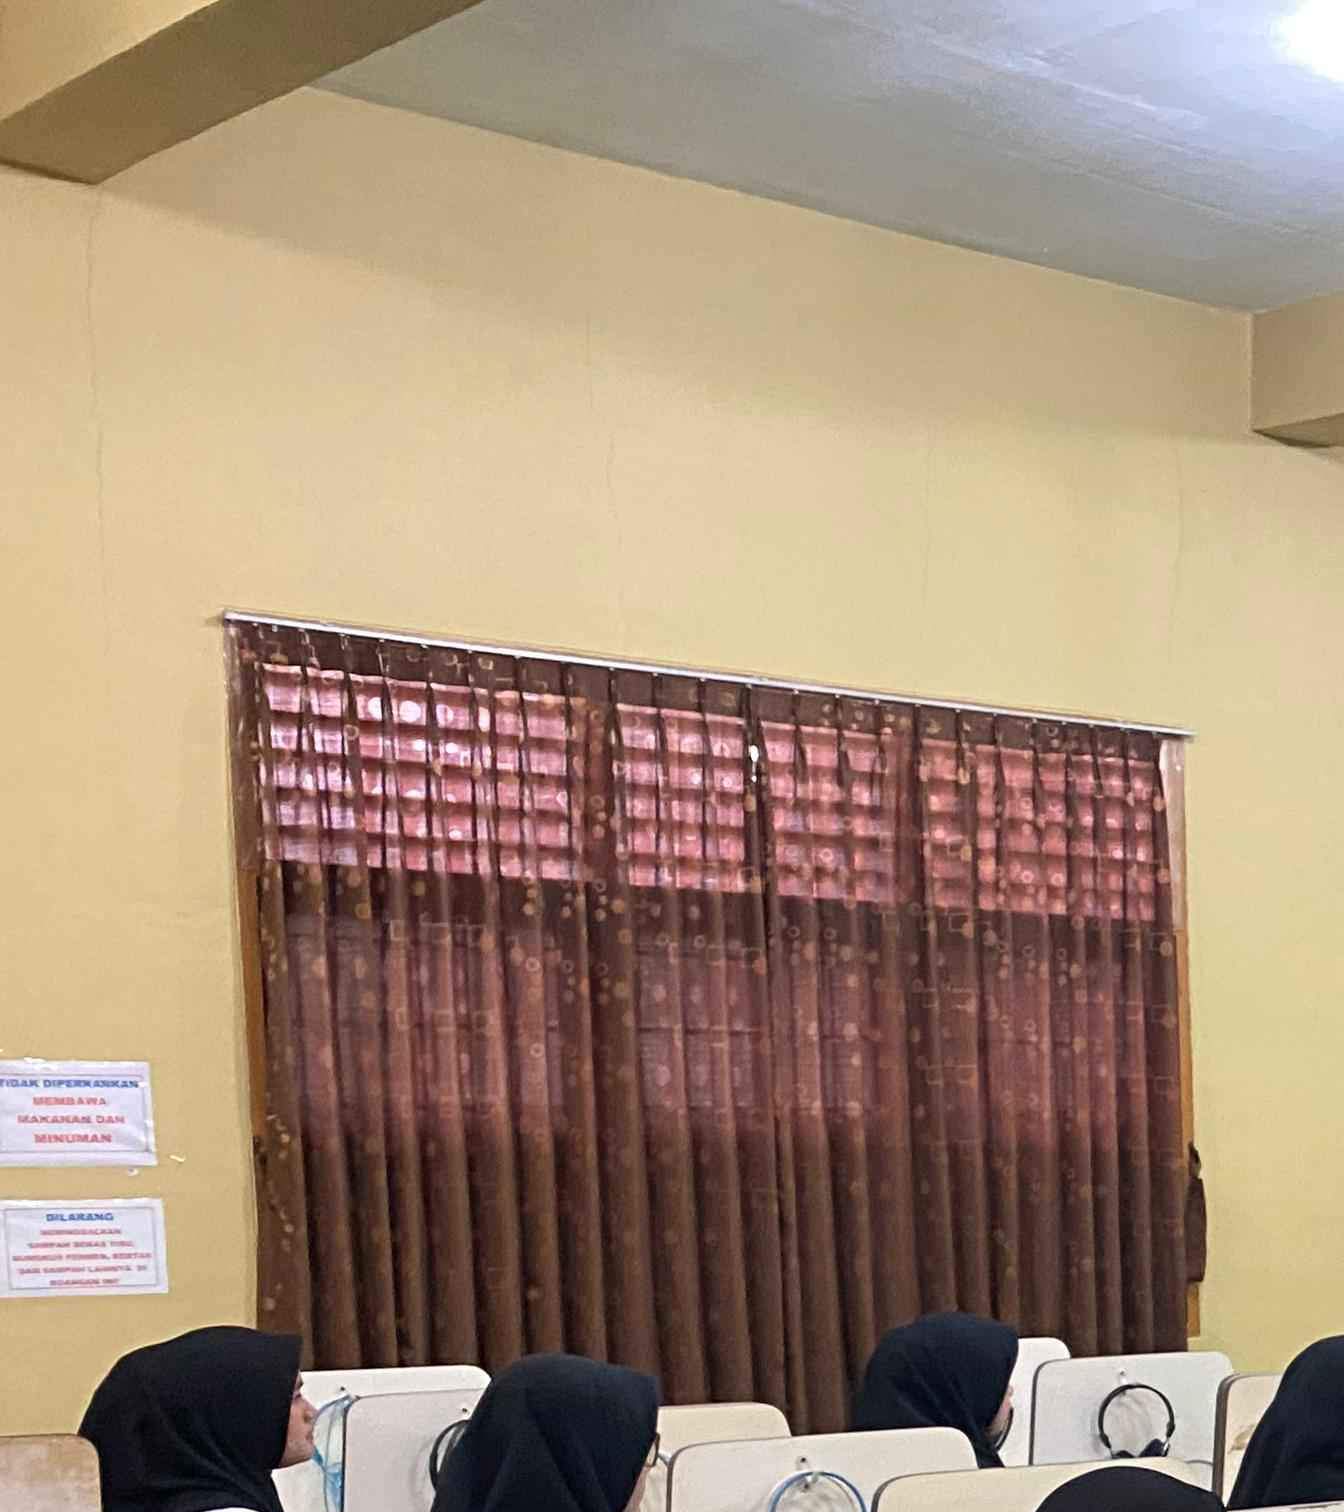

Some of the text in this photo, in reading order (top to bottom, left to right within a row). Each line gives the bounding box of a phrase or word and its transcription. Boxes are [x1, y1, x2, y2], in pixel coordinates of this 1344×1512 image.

[96, 1114, 125, 1124] DAN
[34, 1133, 112, 1144] MINUMAN
[46, 1212, 114, 1222] DILARANG
